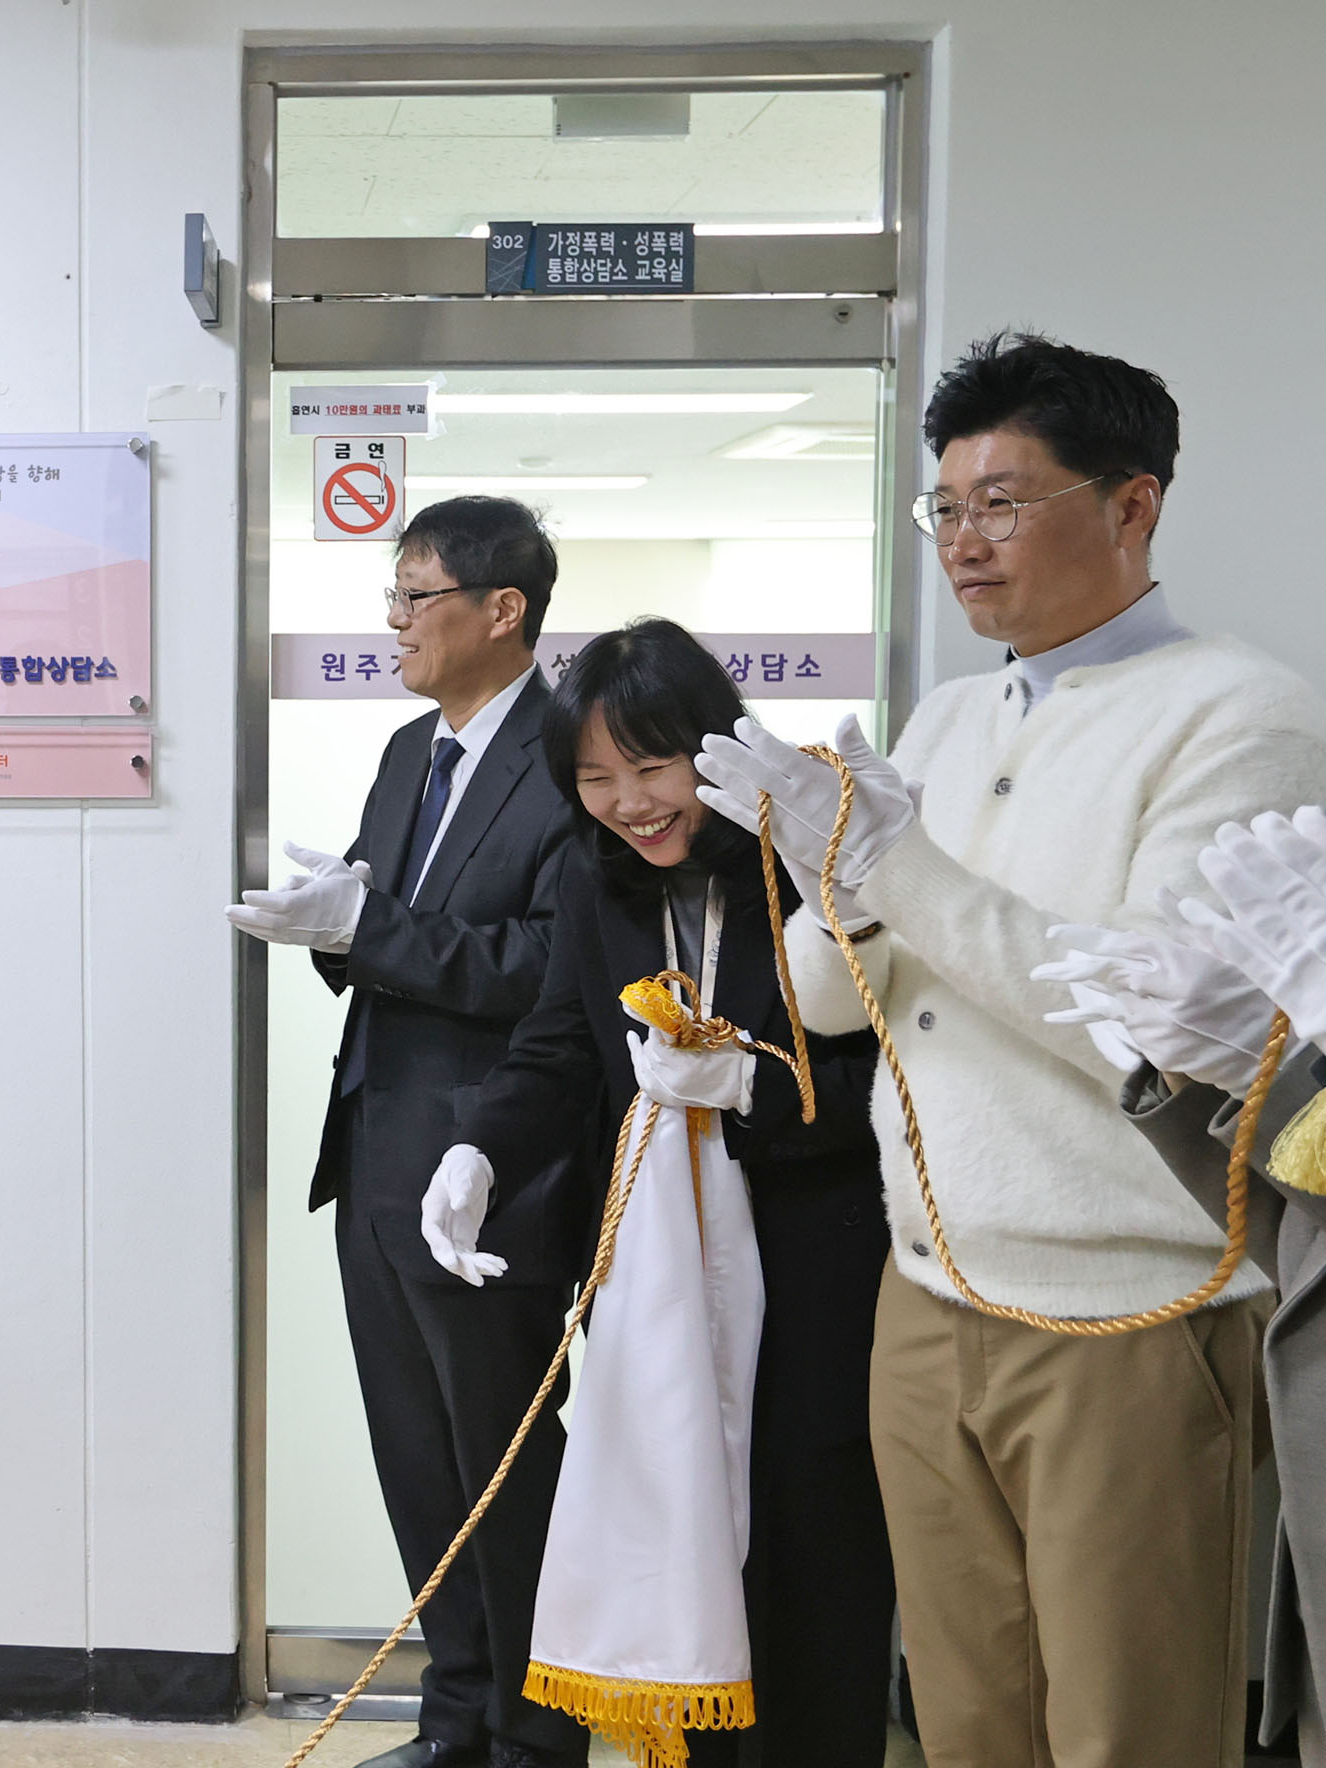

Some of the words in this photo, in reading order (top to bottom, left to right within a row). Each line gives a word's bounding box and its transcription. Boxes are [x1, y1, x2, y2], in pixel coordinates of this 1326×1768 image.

[492, 235, 524, 249] 302
[547, 258, 628, 283] 통합상담소
[635, 258, 684, 283] 교육실
[326, 404, 368, 416] 10만원의
[373, 404, 401, 415] 과태료
[406, 403, 426, 414] 부과
[27, 464, 61, 482] 향해
